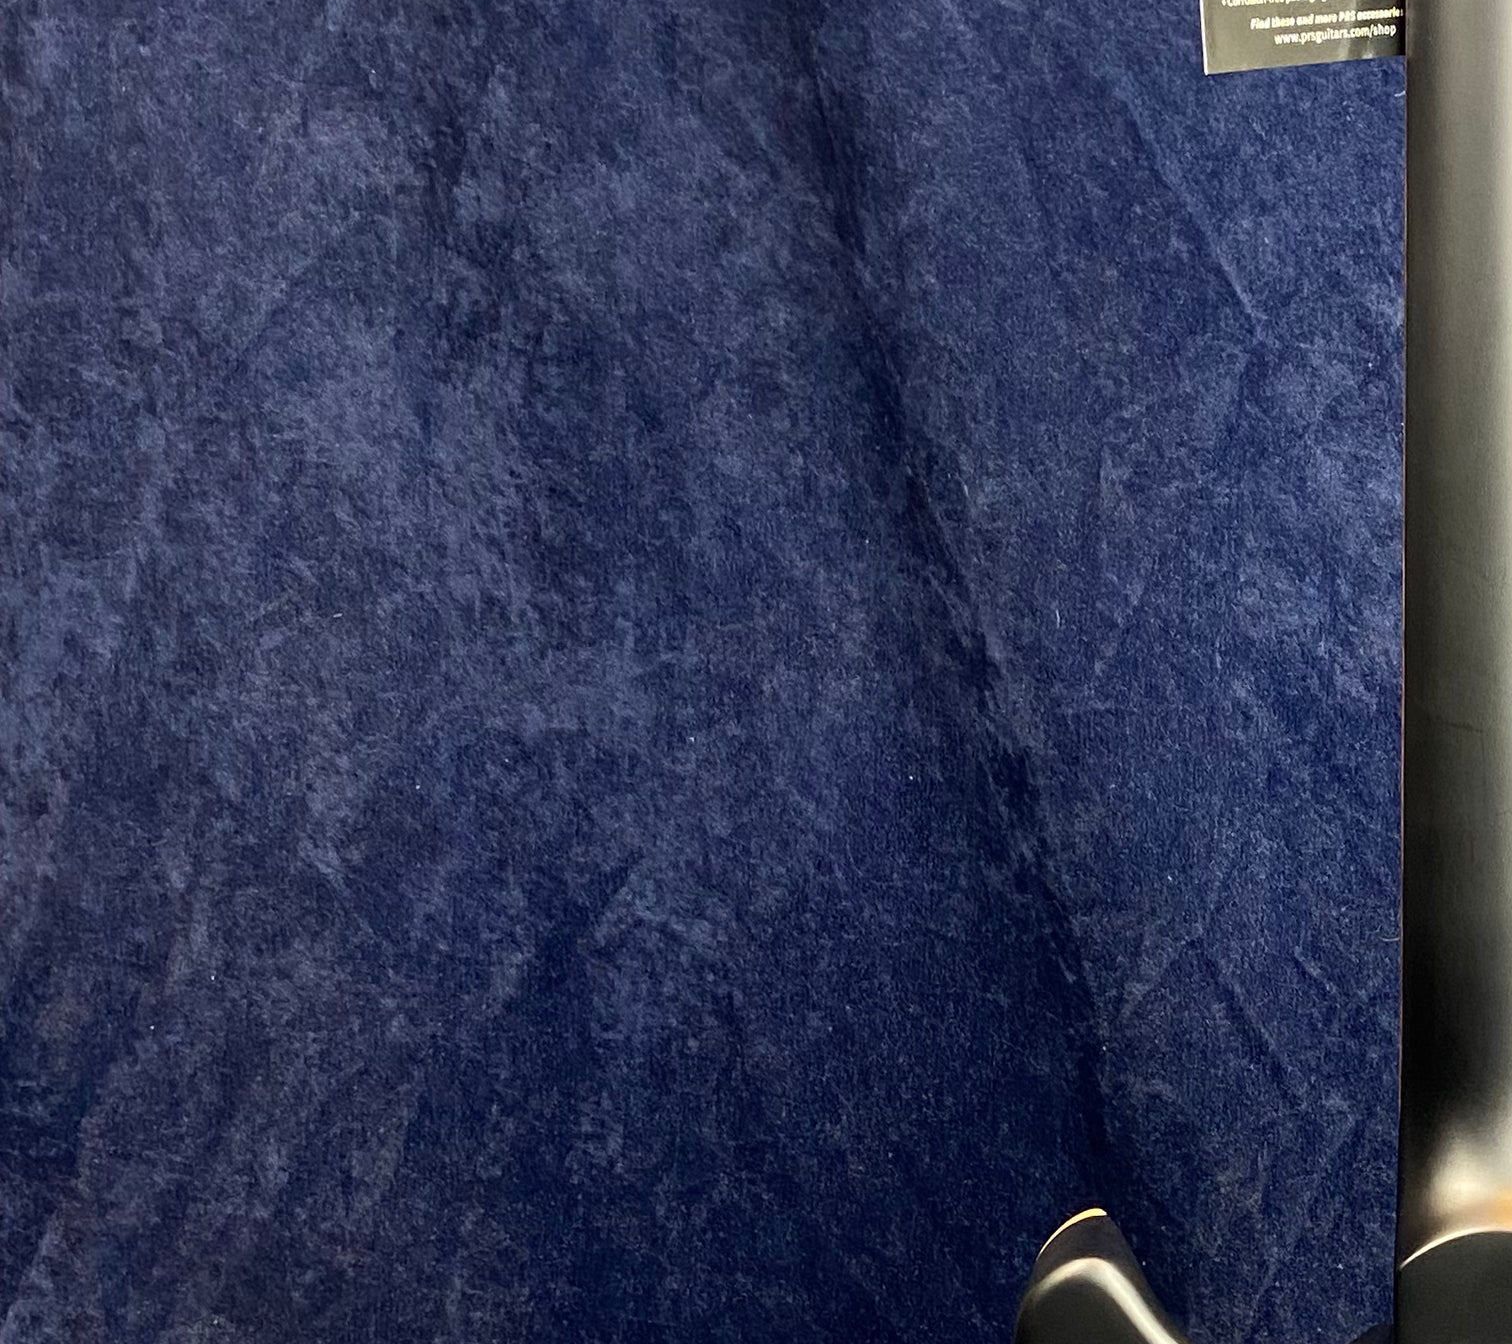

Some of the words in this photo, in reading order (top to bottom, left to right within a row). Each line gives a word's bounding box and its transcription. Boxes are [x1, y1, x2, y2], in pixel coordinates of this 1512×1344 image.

[1250, 17, 1271, 30] Find
[1271, 16, 1295, 28] these
[1296, 13, 1314, 26] and
[1314, 13, 1338, 24] more
[1338, 10, 1356, 22] PRS
[1274, 23, 1397, 46] www.prsguitars.com/shop
